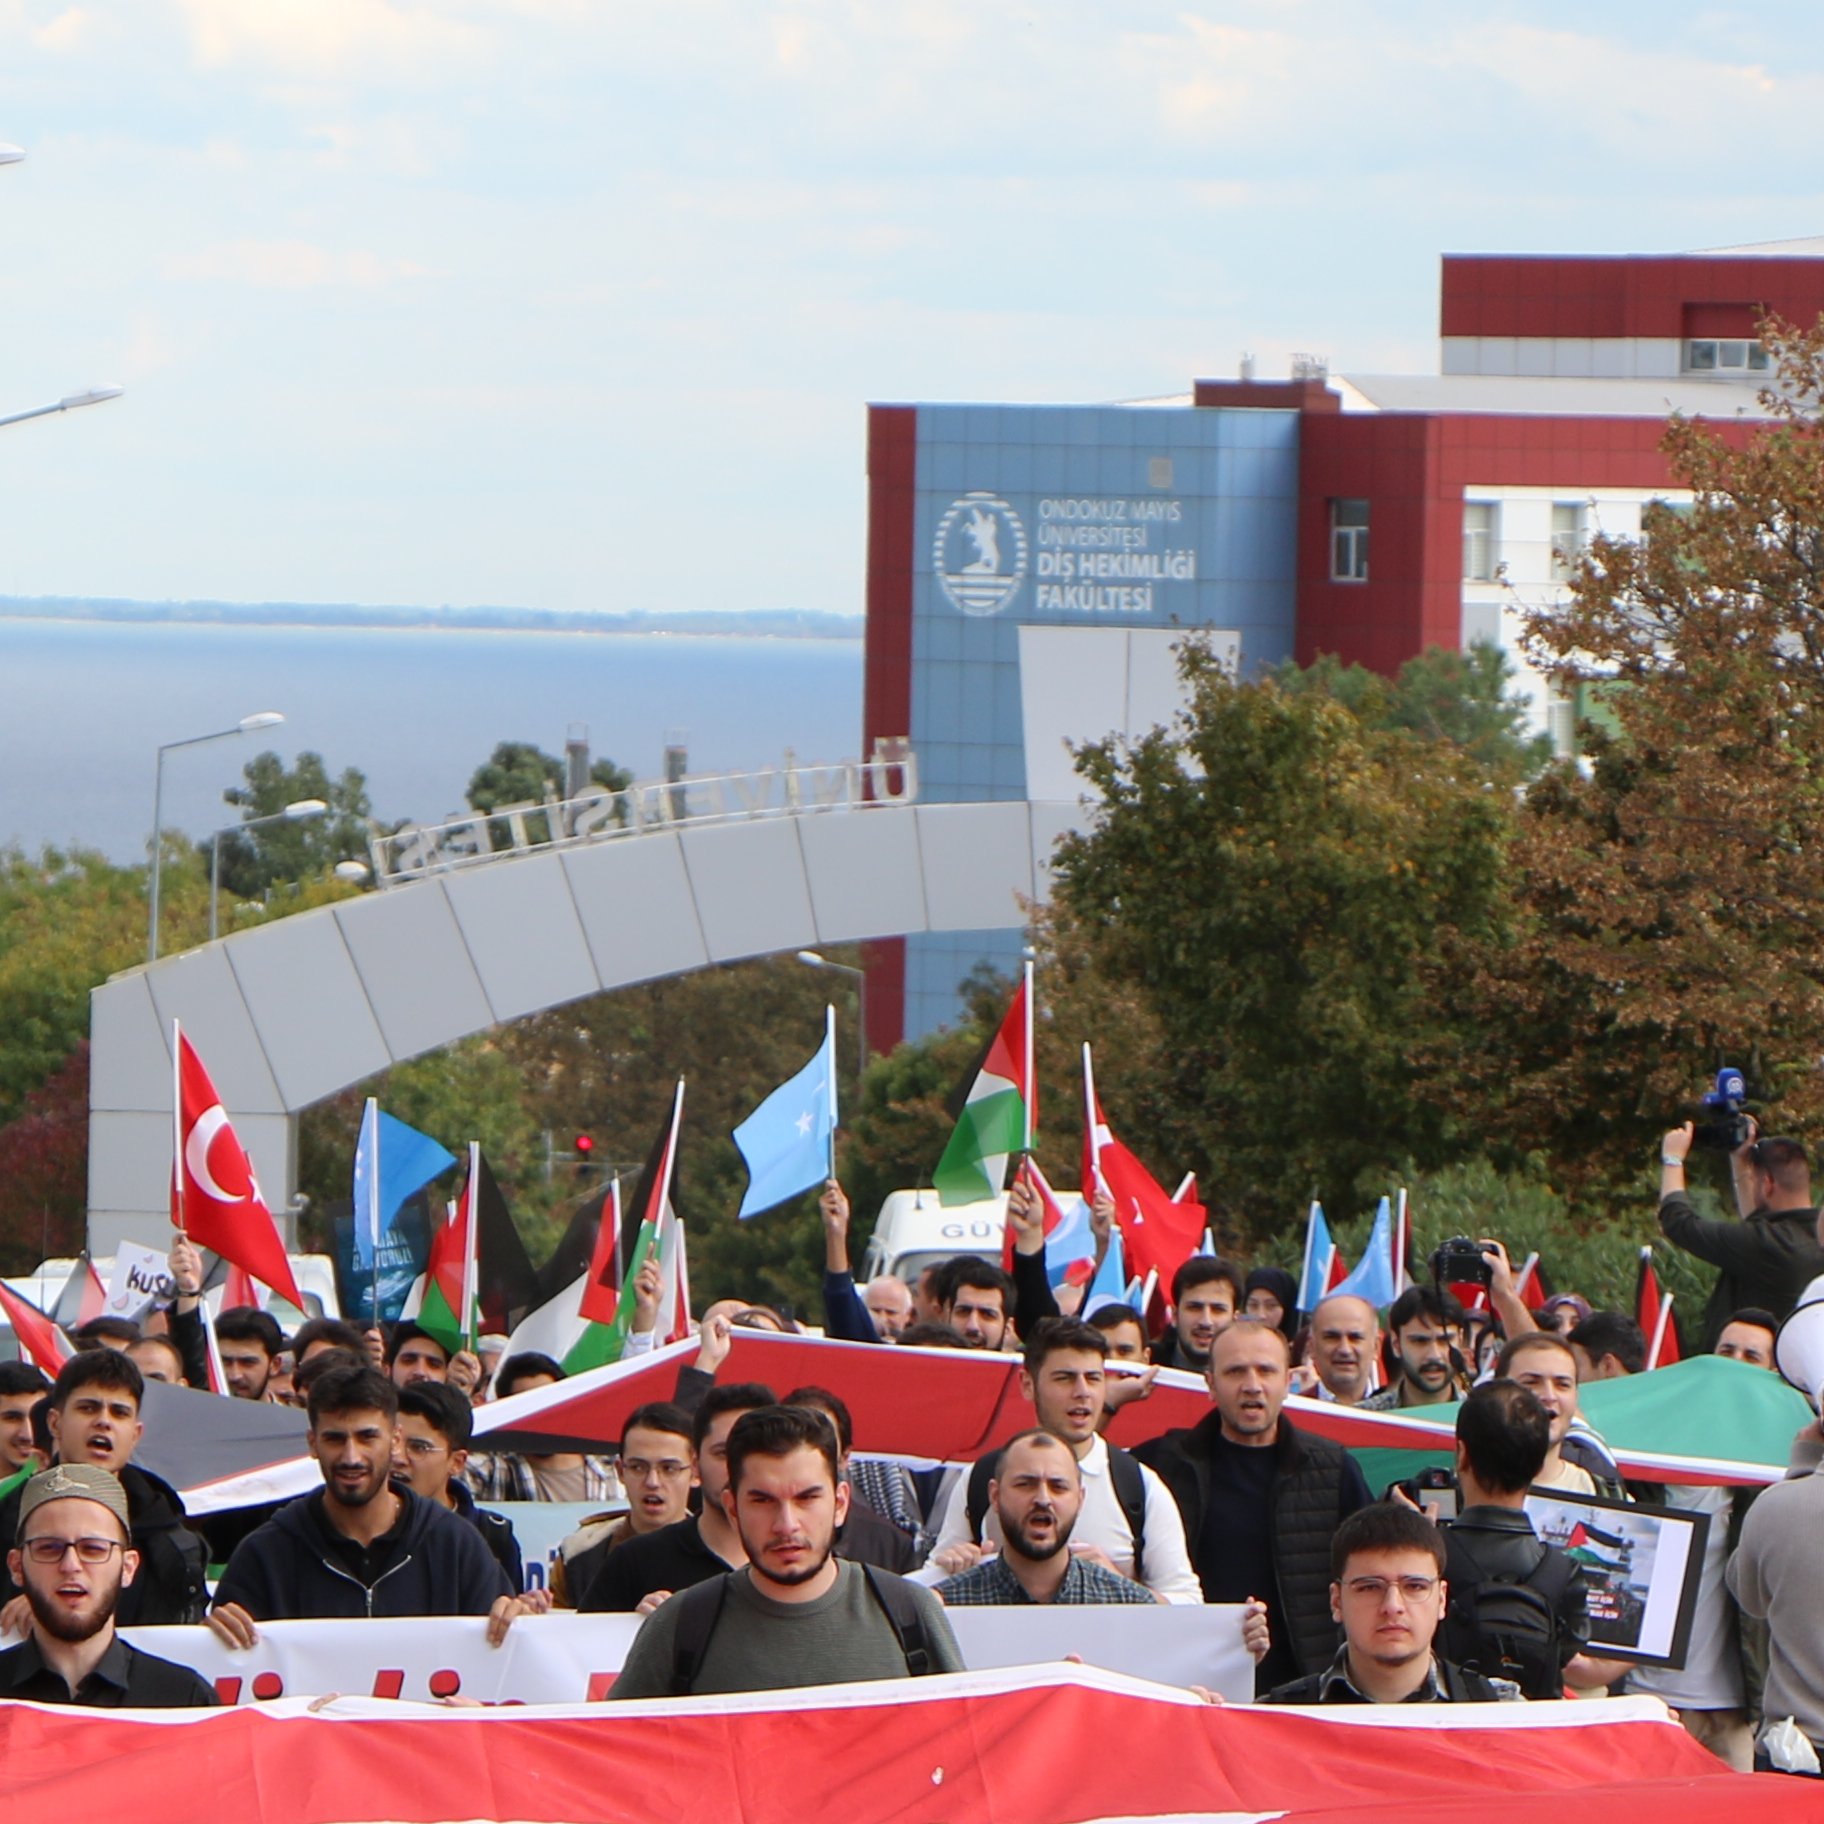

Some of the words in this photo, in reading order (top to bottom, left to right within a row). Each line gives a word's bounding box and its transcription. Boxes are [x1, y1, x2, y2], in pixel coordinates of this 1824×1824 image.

[1038, 499, 1126, 520] ONDOKUZ
[1130, 500, 1182, 521] MAYIS
[1038, 522, 1147, 546] ÜNİVERSİTESİ
[1037, 546, 1075, 583] DİŞ
[1079, 548, 1196, 579] HEKİMLİĞİ
[1036, 579, 1153, 611] FAKÜLTESİ
